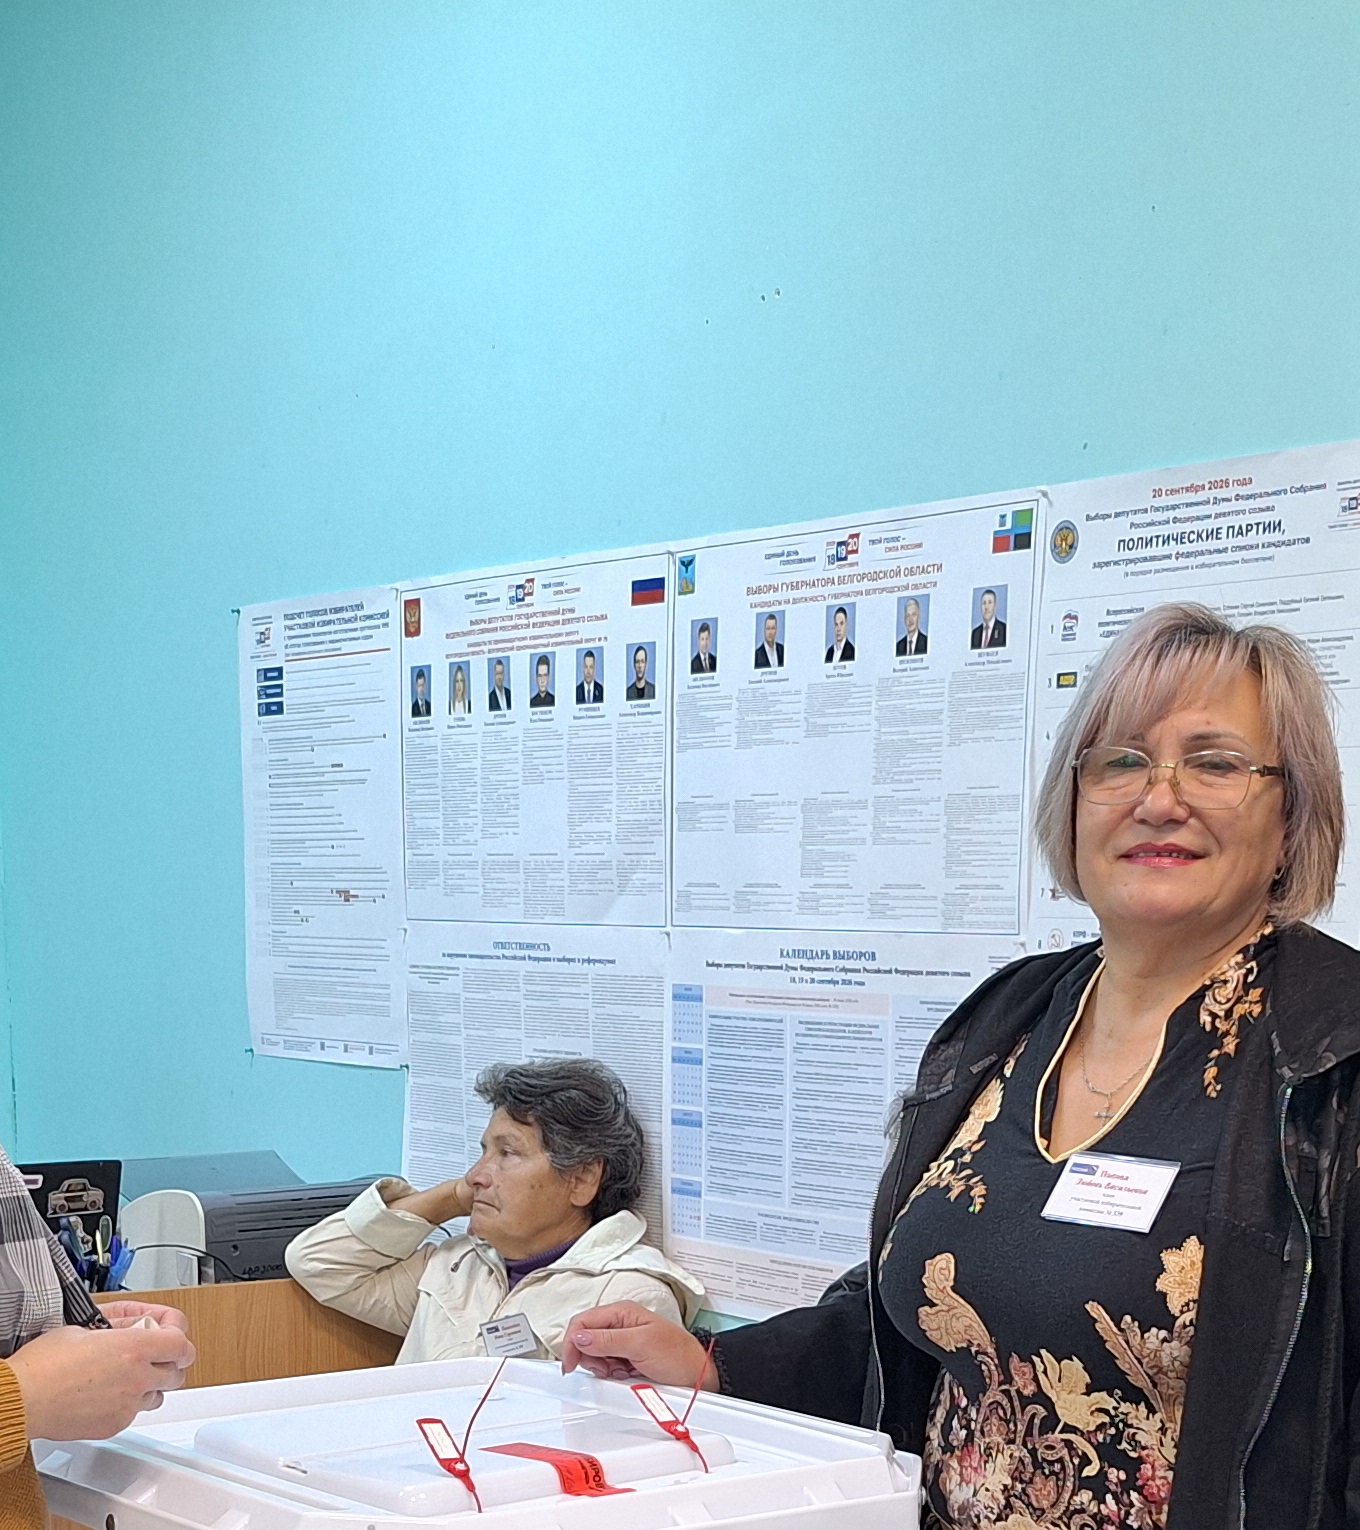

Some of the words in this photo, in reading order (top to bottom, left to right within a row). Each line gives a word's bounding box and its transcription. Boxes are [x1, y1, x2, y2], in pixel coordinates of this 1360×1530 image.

[1151, 488, 1163, 499] 20
[1164, 483, 1206, 496] сентября
[1207, 478, 1230, 490] 2026
[1232, 477, 1253, 488] года
[847, 537, 858, 551] 20
[1117, 526, 1224, 553] ПОЛИТИЧЕСКИЕ
[1225, 518, 1286, 541] ПАРТИИ,
[746, 583, 779, 597] ВЫБОРЫ
[780, 576, 836, 592] ГУБЕРНАТОРА
[837, 565, 902, 587] БЕЛГОРОДСКОЙ
[903, 562, 943, 578] ОБЛАСТИ
[779, 948, 831, 961] КАЛЕНДАРЬ
[832, 949, 877, 962] ВЫБОРОВ
